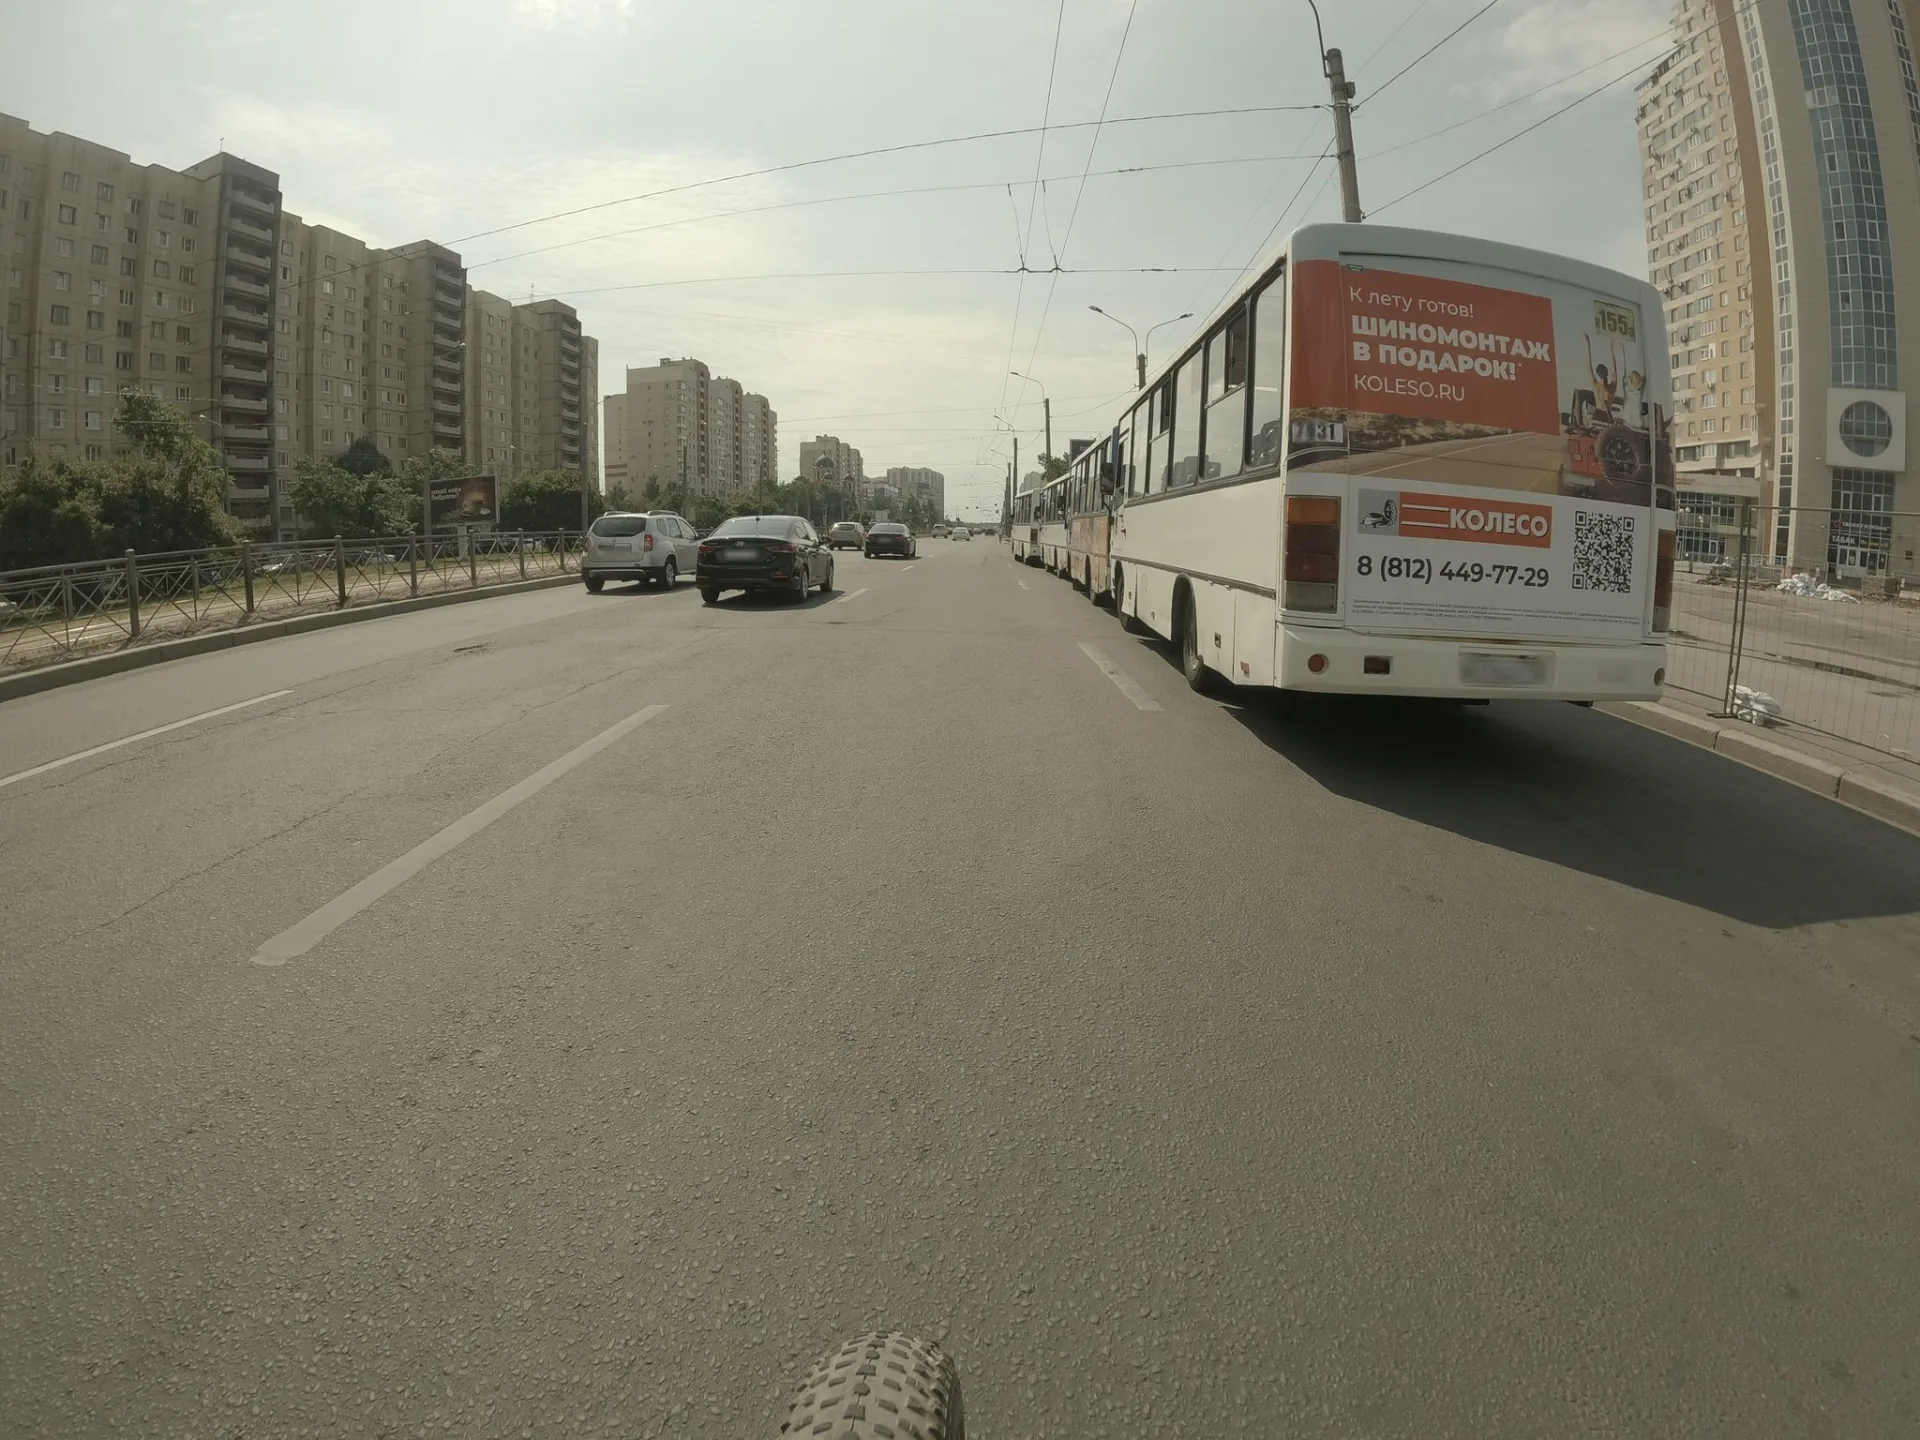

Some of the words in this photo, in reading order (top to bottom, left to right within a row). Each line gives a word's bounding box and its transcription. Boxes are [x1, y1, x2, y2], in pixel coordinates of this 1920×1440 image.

[1350, 286, 1363, 303] К
[1368, 292, 1412, 312] лету
[1418, 299, 1474, 318] готов!
[1351, 315, 1551, 361] ШИНОМОНТАЖ
[1353, 341, 1371, 361] В
[1354, 373, 1465, 401] KOLESO.RU
[1450, 508, 1548, 537] КОЛЕСО
[1831, 535, 1856, 544] ТАБАК
[1357, 555, 1373, 576] 8
[1380, 556, 1432, 584] (812)
[1439, 560, 1550, 588] 449-77-29
